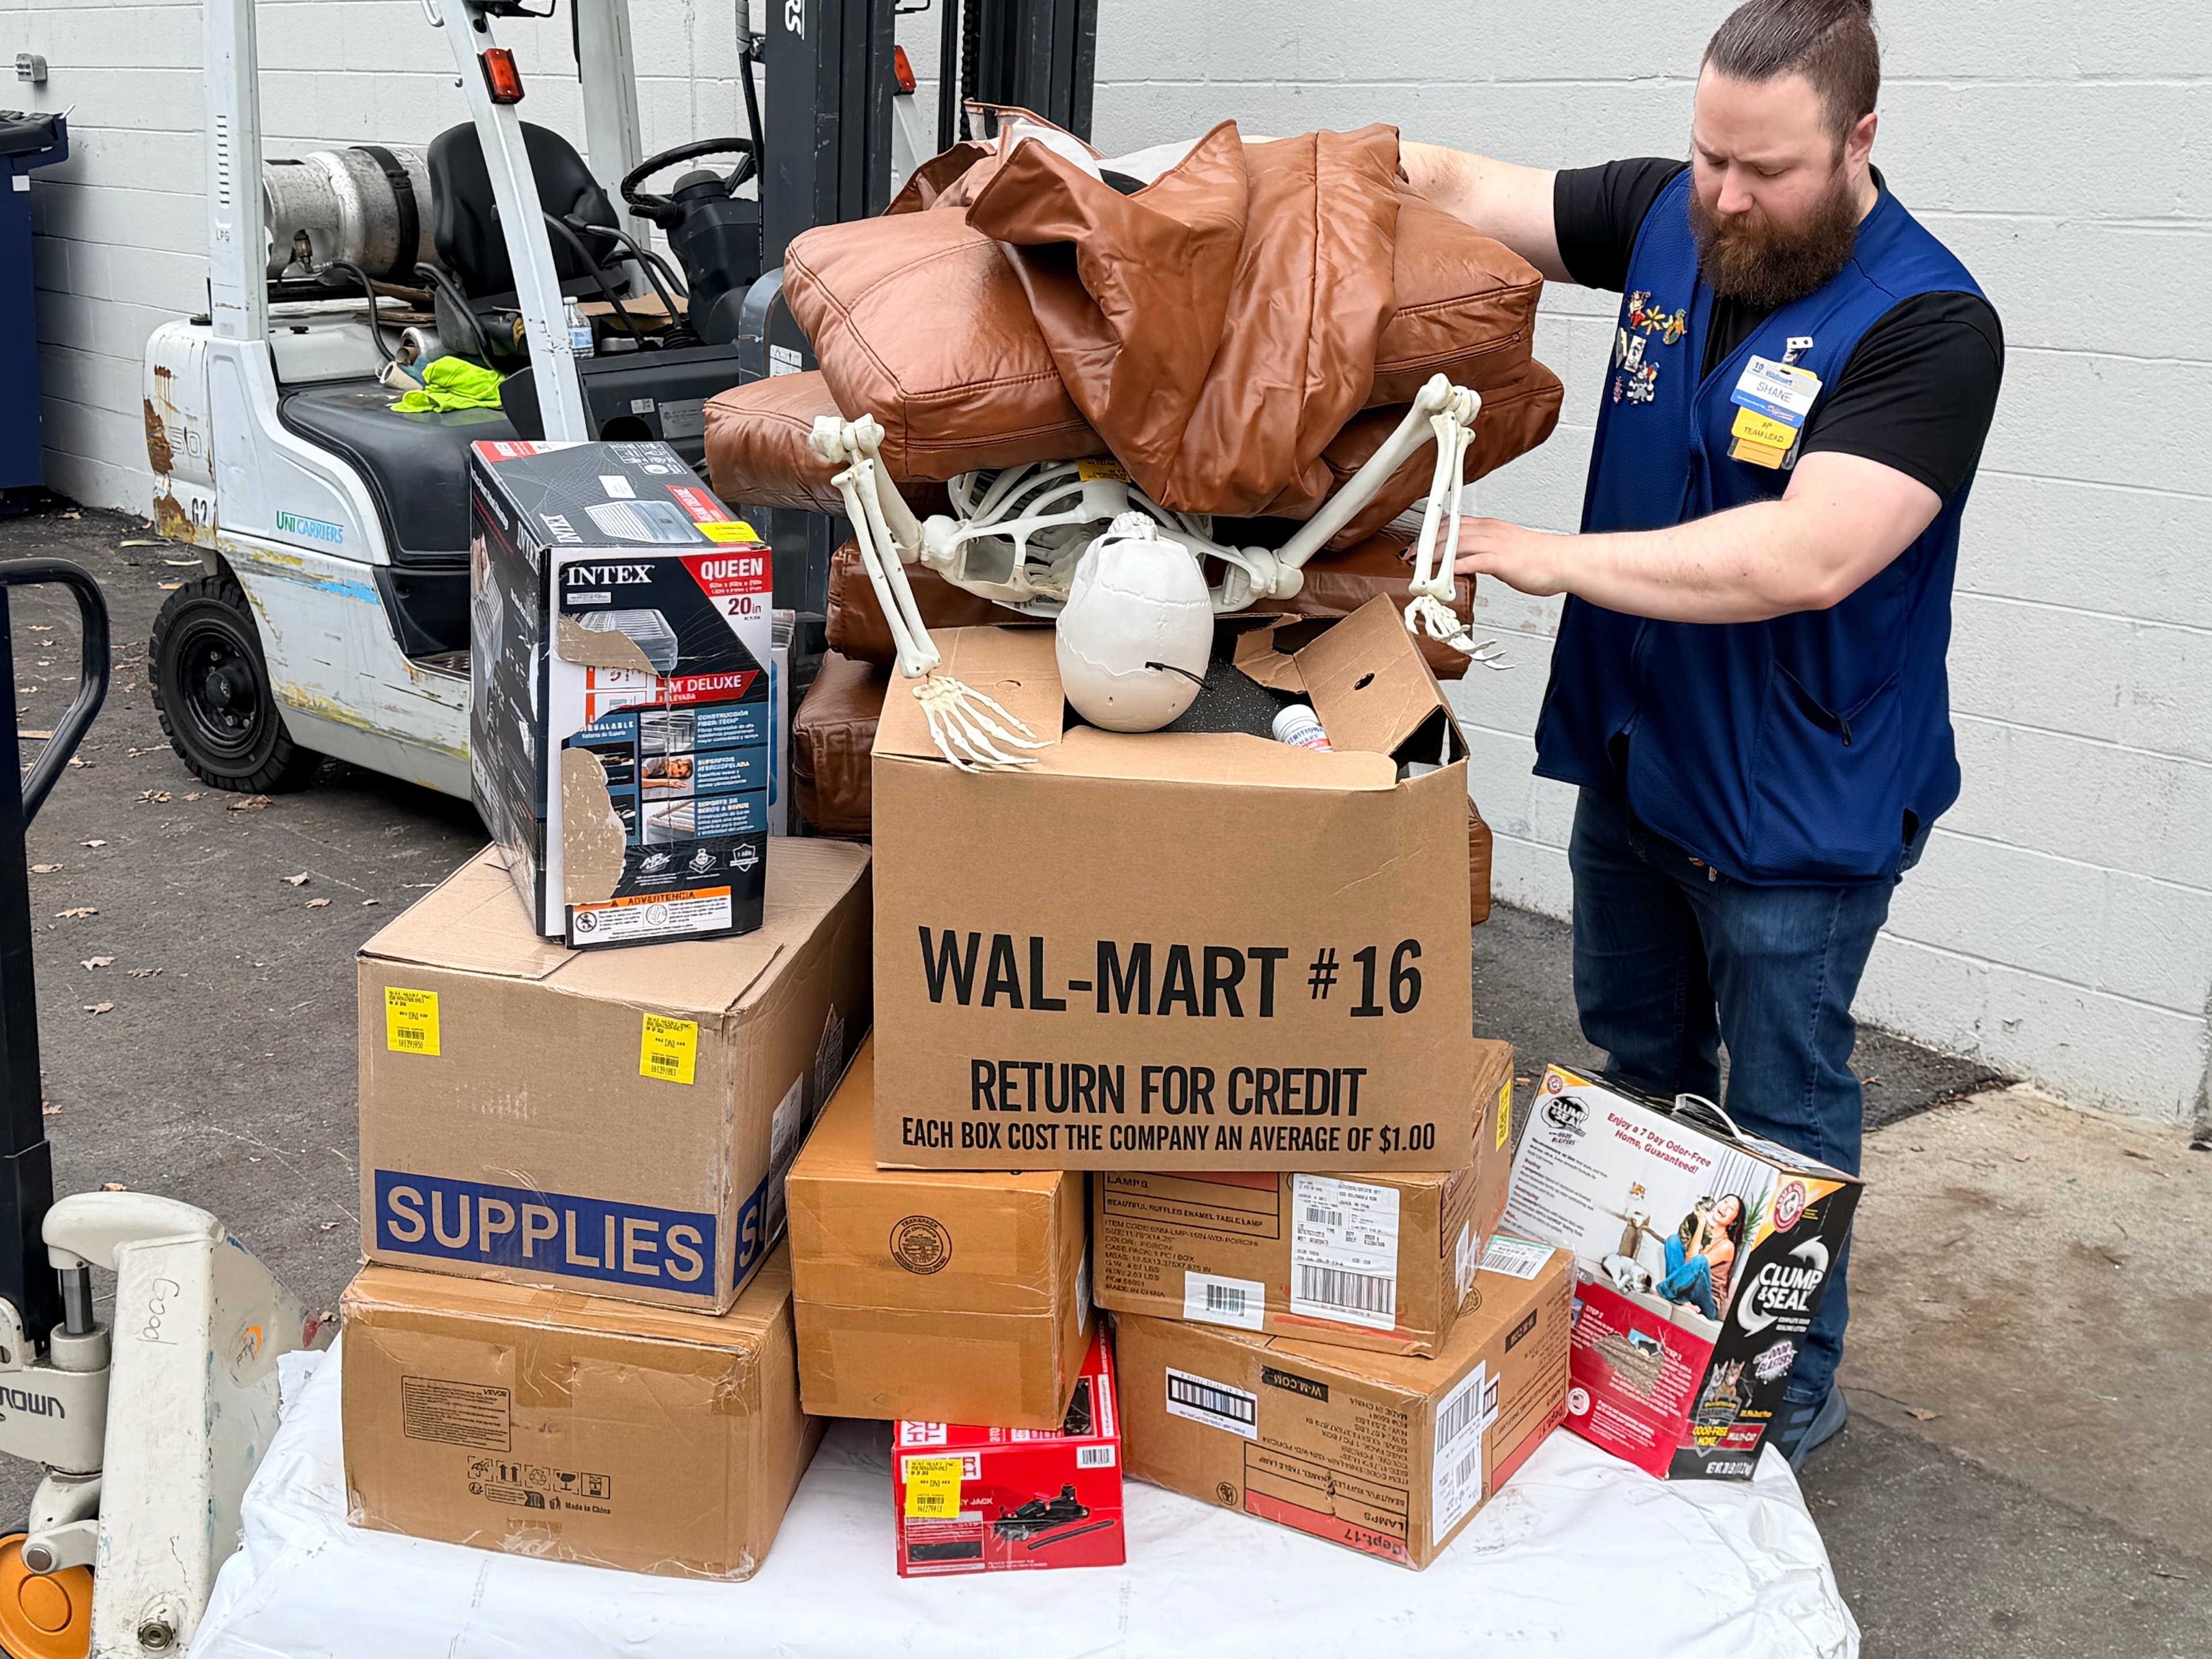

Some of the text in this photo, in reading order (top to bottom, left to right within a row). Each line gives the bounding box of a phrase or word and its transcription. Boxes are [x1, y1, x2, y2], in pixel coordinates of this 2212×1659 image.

[1757, 381, 1793, 403] SHANE
[1745, 427, 1783, 442] TEAM LEAD
[567, 565, 655, 585] INTEX
[700, 558, 763, 581] QUEEN
[687, 675, 741, 692] DELUXE
[919, 926, 1289, 1018] WAL-MART
[971, 1058, 1367, 1116] RETURN FOR CREDIT
[1551, 1100, 1588, 1123] CLUMP
[903, 1116, 1435, 1154] EACH BOX COST THE COMPANY AN AVERAGE OF $1.00
[1607, 1113, 1632, 1130] Enjoy
[1641, 1128, 1647, 1137] 7
[1647, 1131, 1665, 1146] Day
[1666, 1141, 1711, 1168] Odor-Free
[1615, 1129, 1699, 1175] Home, Guaranteed!
[1107, 1175, 1148, 1188] LAMPS
[1107, 1198, 1147, 1210] BEAUTIFUL
[1184, 1210, 1214, 1220] ENAMEL
[1216, 1214, 1240, 1225] TABLE
[1241, 1218, 1263, 1227] LAMP
[1105, 1219, 1124, 1228] ITEM
[388, 1185, 703, 1282] SUPPLIES
[1105, 1244, 1127, 1253] CASE
[1177, 1253, 1195, 1262] BOX
[1759, 1262, 1824, 1290] CLUMP
[1105, 1283, 1128, 1292] MADE
[1141, 1287, 1165, 1298] CHINA
[1757, 1286, 1808, 1310] &SEAL
[1586, 1304, 1599, 1316] STEP
[483, 1389, 507, 1397] VEVOR
[1350, 1397, 1374, 1410] CHINA
[1385, 1408, 1407, 1421] MADE
[1322, 1430, 1338, 1440] BOX
[1343, 1437, 1354, 1446] PC
[1259, 1457, 1278, 1467] LAMP
[1387, 1450, 1407, 1461] CASE
[1280, 1463, 1302, 1475] TABLE
[1389, 1476, 1408, 1484] ITEM
[1365, 1491, 1405, 1506] BEAUTIFUL
[565, 1502, 582, 1511] Made
[592, 1506, 611, 1515] China
[1364, 1512, 1404, 1531] LAMPS
